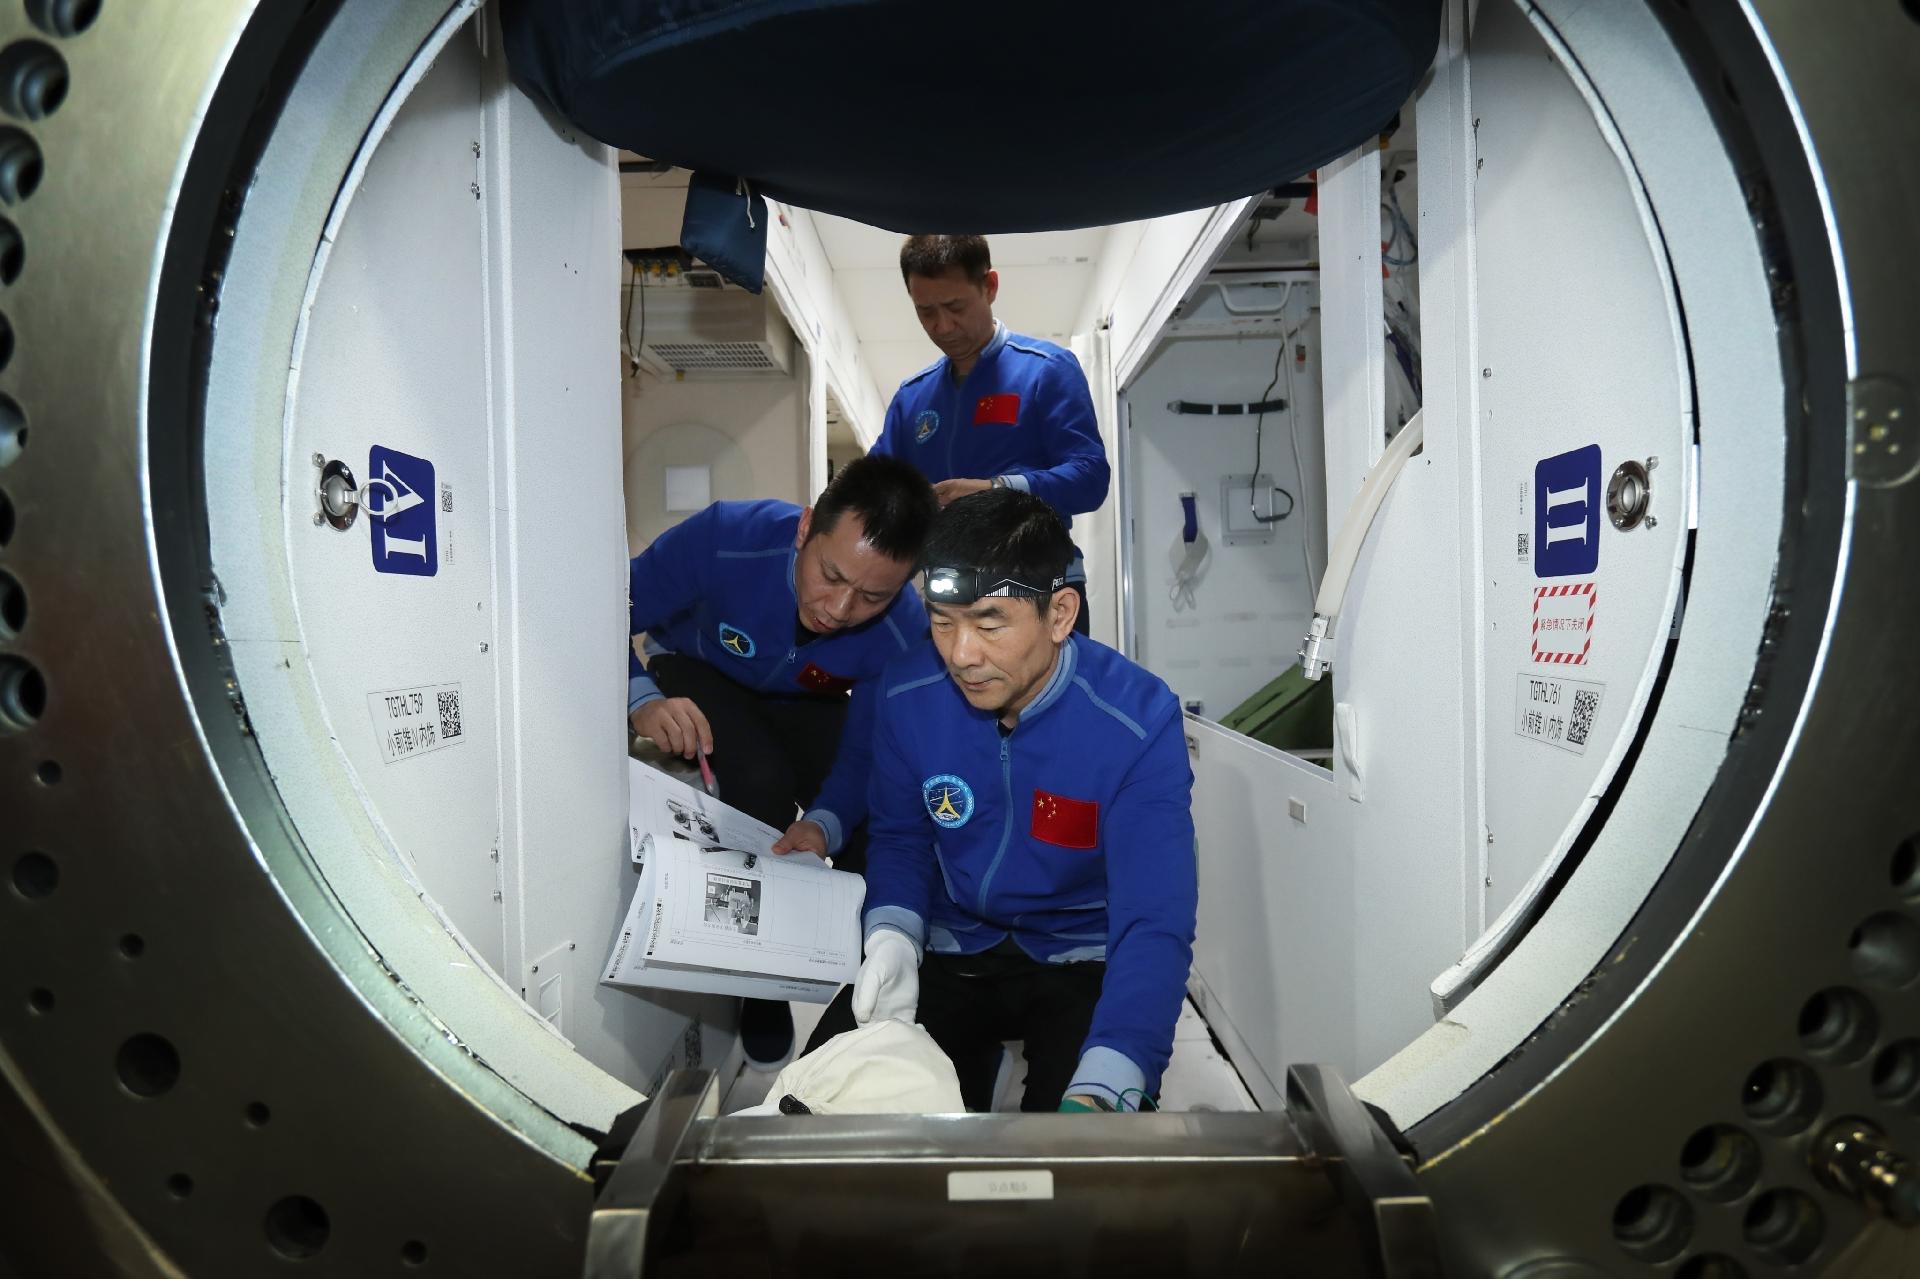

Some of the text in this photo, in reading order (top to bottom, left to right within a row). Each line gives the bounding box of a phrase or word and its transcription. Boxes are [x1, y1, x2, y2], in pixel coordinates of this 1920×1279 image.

[382, 459, 427, 563] IV
[1546, 476, 1588, 550] II
[384, 692, 423, 719] TGTHL759
[1530, 680, 1562, 705] TGTHL761
